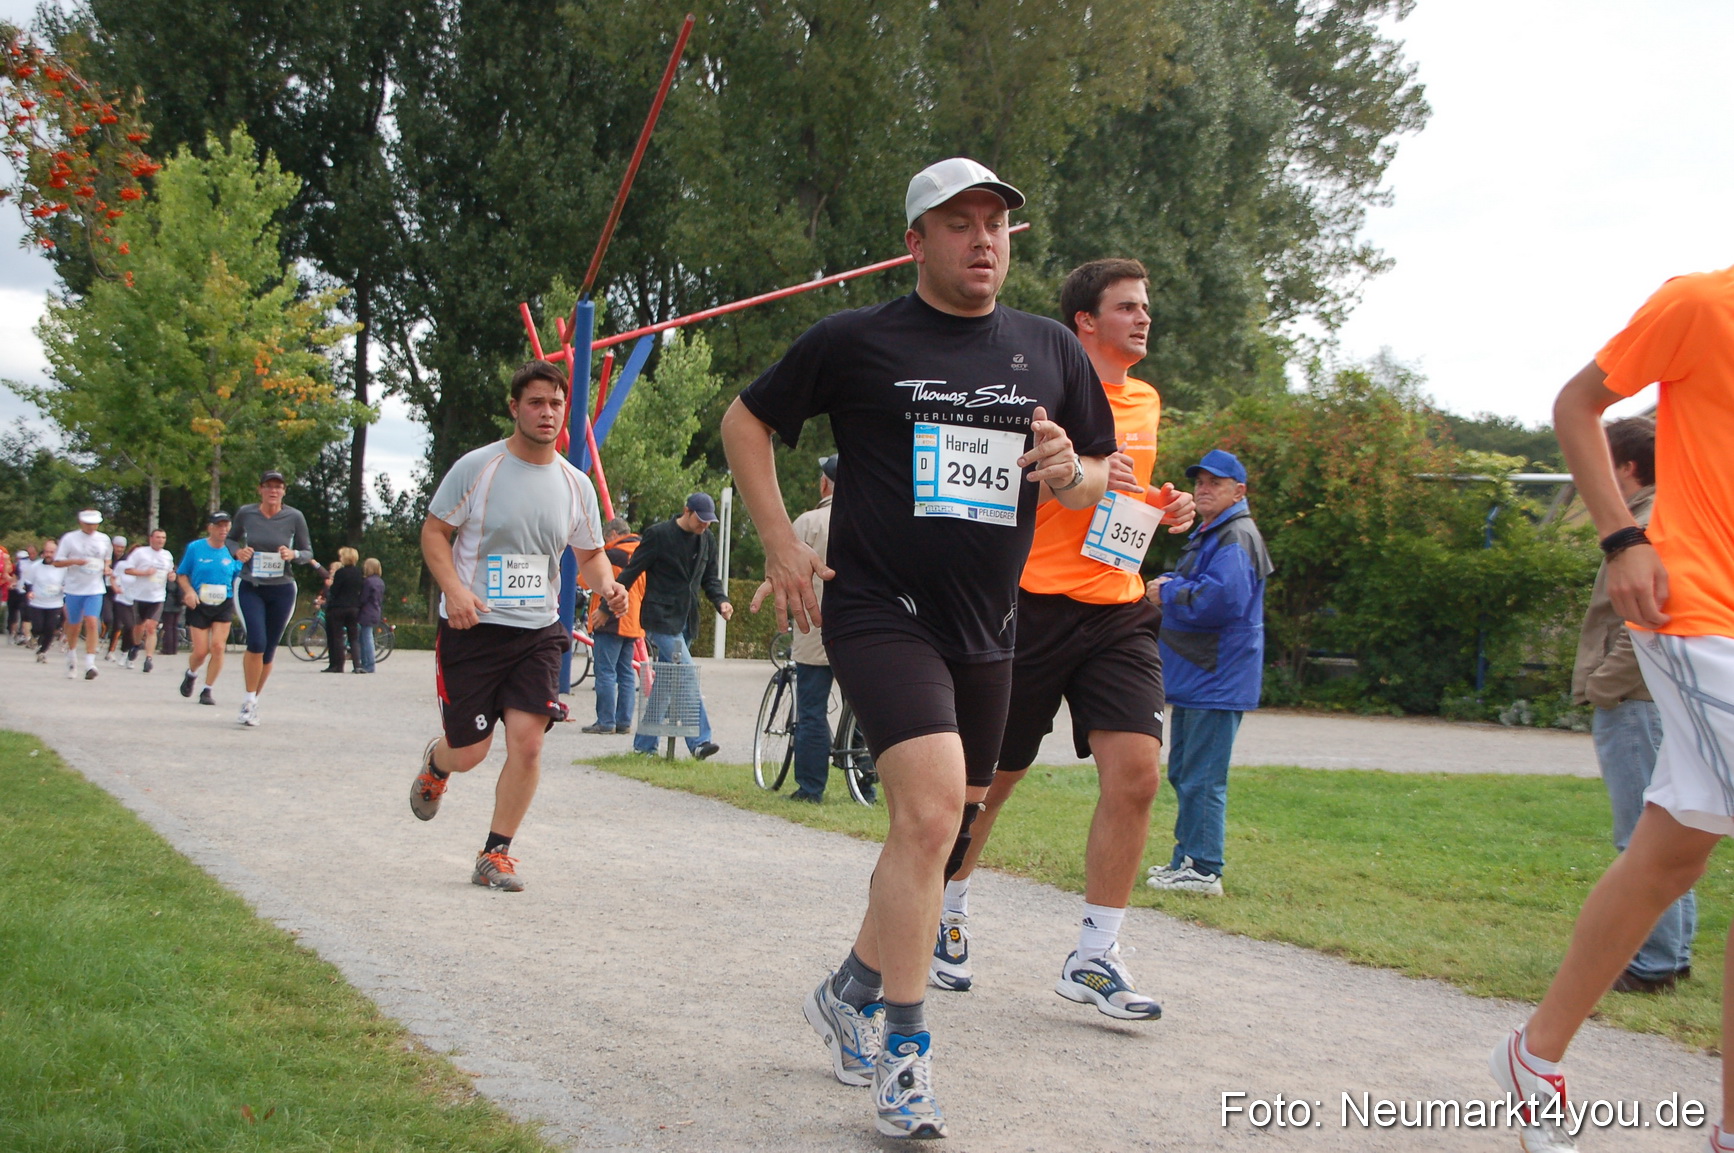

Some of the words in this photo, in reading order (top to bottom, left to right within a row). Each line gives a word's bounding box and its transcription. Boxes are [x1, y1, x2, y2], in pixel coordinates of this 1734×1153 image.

[894, 379, 968, 406] Thomas
[965, 384, 1037, 408] Sabo
[905, 412, 974, 422] STERLING
[984, 415, 1030, 425] SILVER
[946, 434, 989, 454] Harald
[920, 457, 928, 470] D
[947, 461, 1010, 491] 2945
[978, 508, 1015, 521] PFLEIDERER
[1111, 522, 1146, 549] 3515
[262, 561, 282, 569] 2862
[507, 560, 529, 569] Marco
[508, 575, 542, 588] 2073
[475, 713, 488, 730] 8
[950, 928, 960, 940] S
